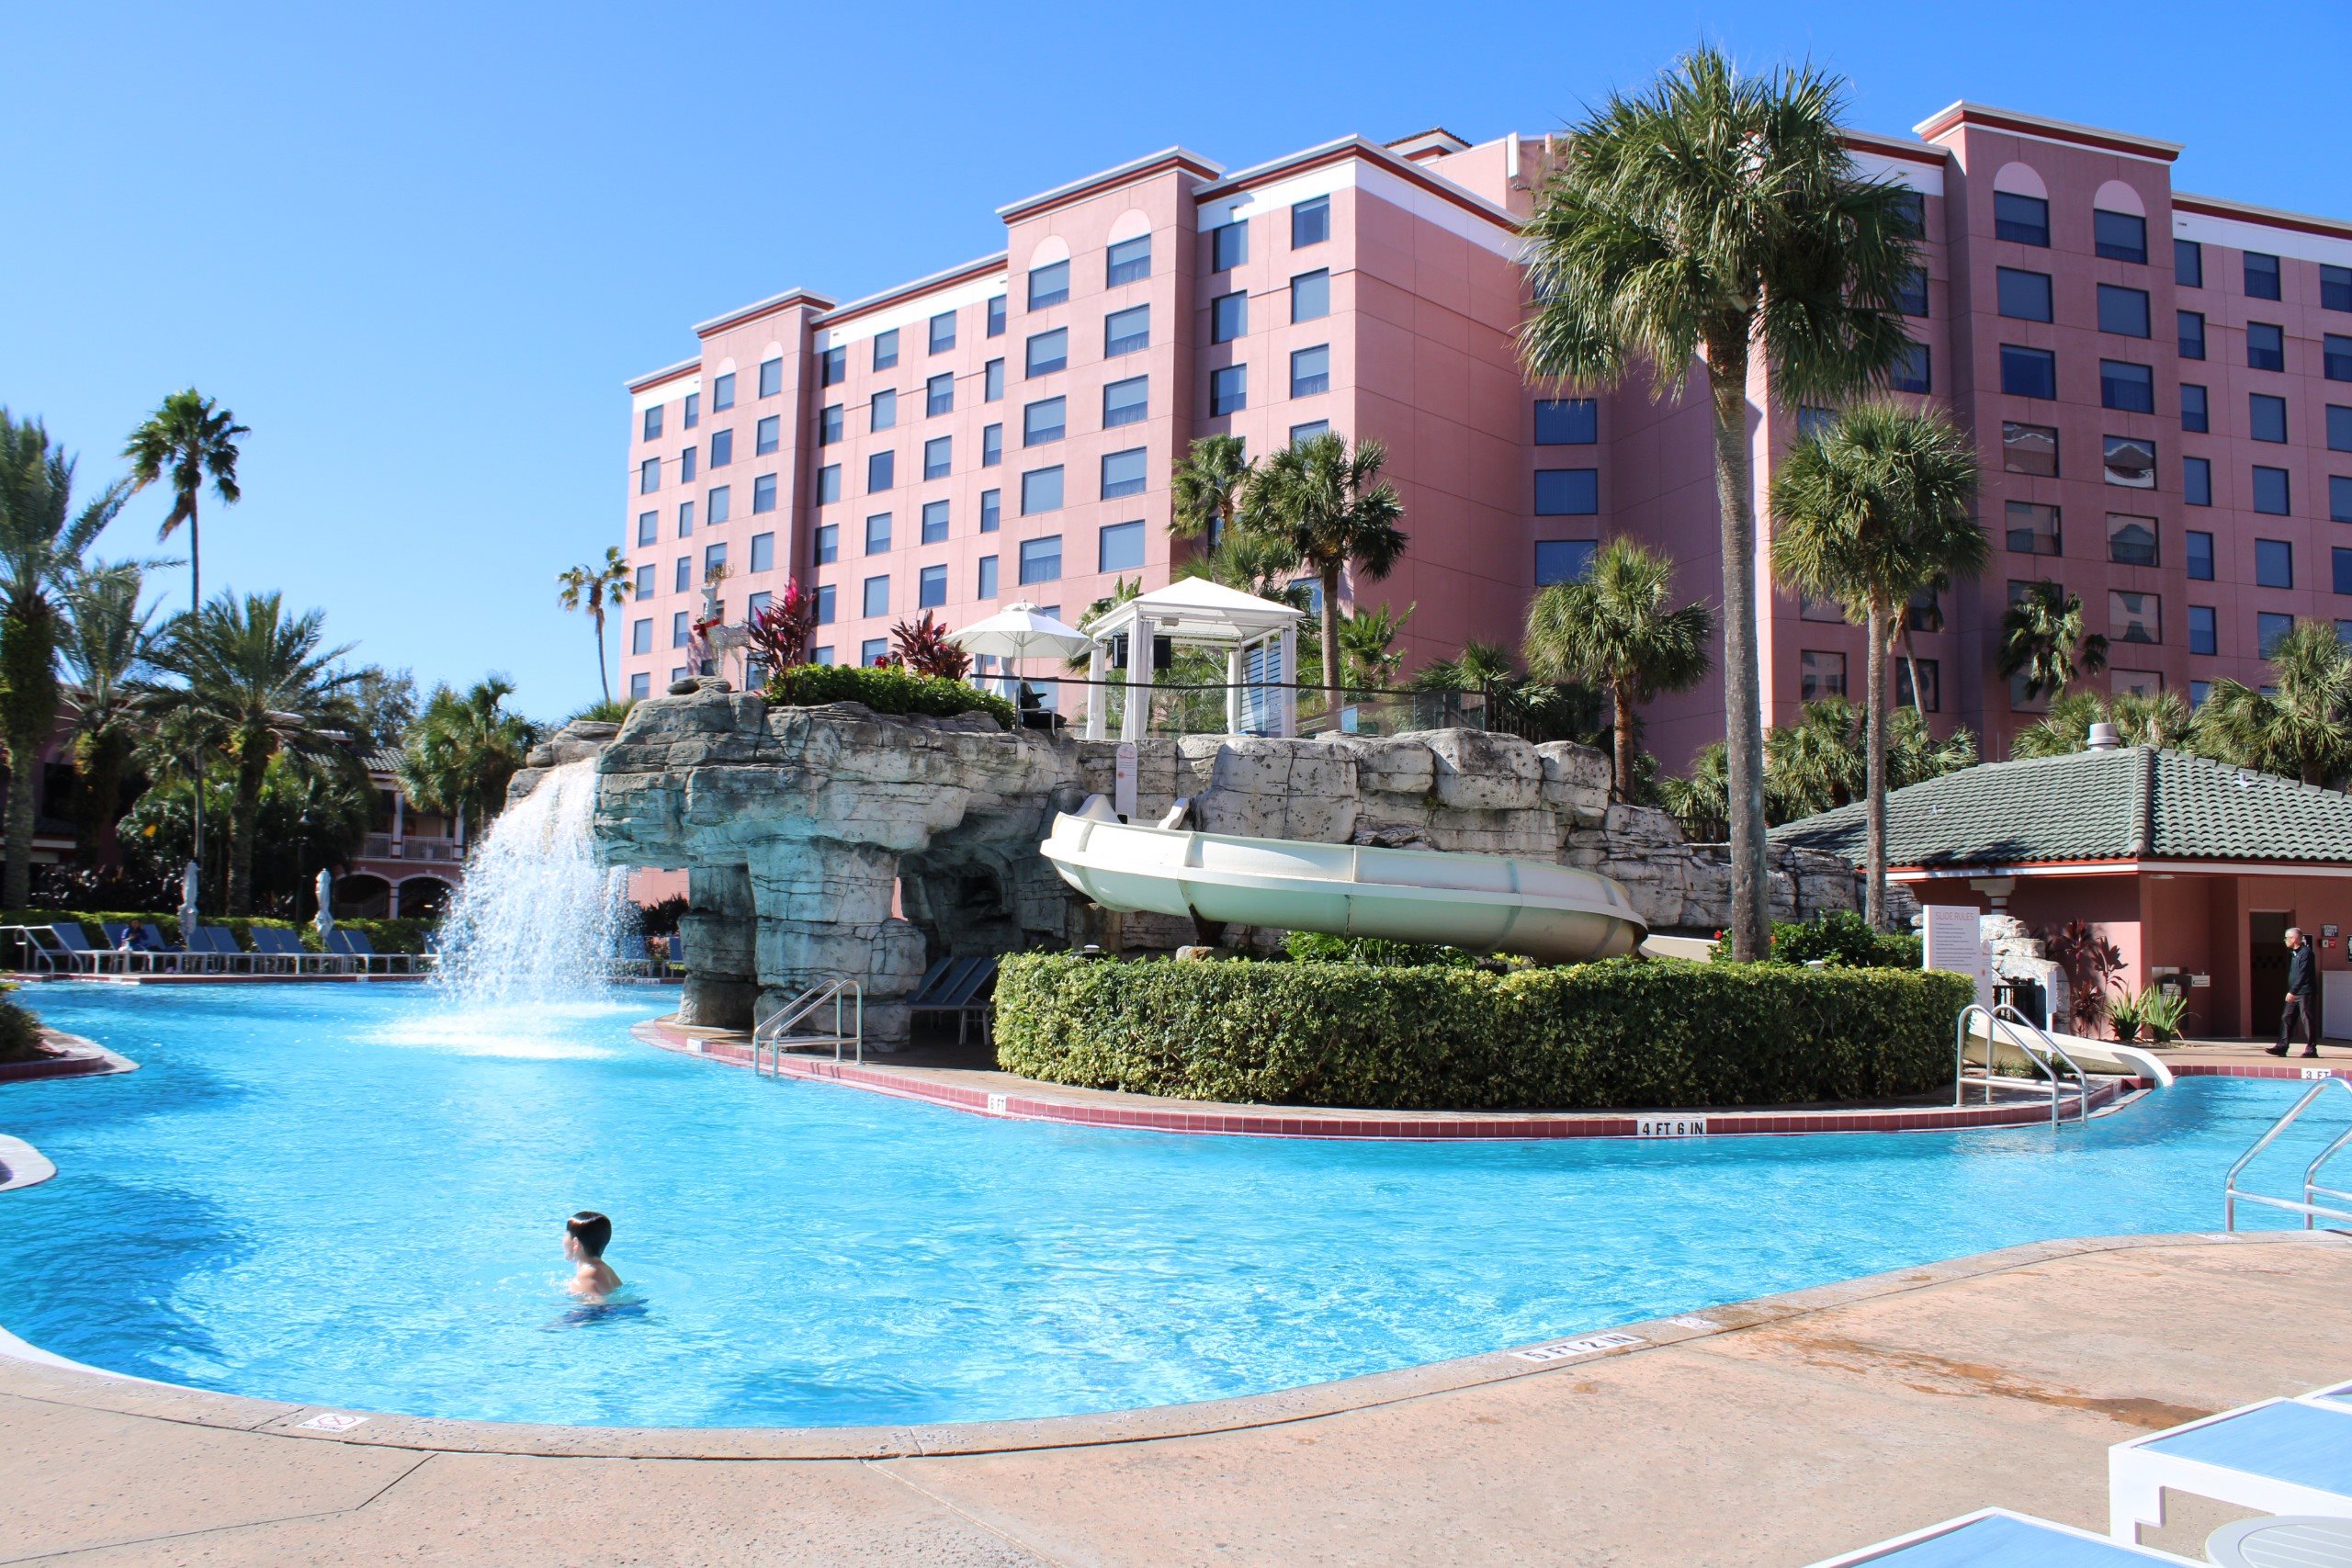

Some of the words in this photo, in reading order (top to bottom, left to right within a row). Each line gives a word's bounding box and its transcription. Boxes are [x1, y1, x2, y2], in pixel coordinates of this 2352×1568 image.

[1935, 911, 1953, 920] SLIDE
[1954, 911, 1974, 921] RULES
[2306, 1070, 2312, 1079] 3
[2317, 1070, 2329, 1079] FT
[1642, 1122, 1650, 1135] 4
[1677, 1122, 1685, 1135] 6
[1578, 1340, 1608, 1348] 2
